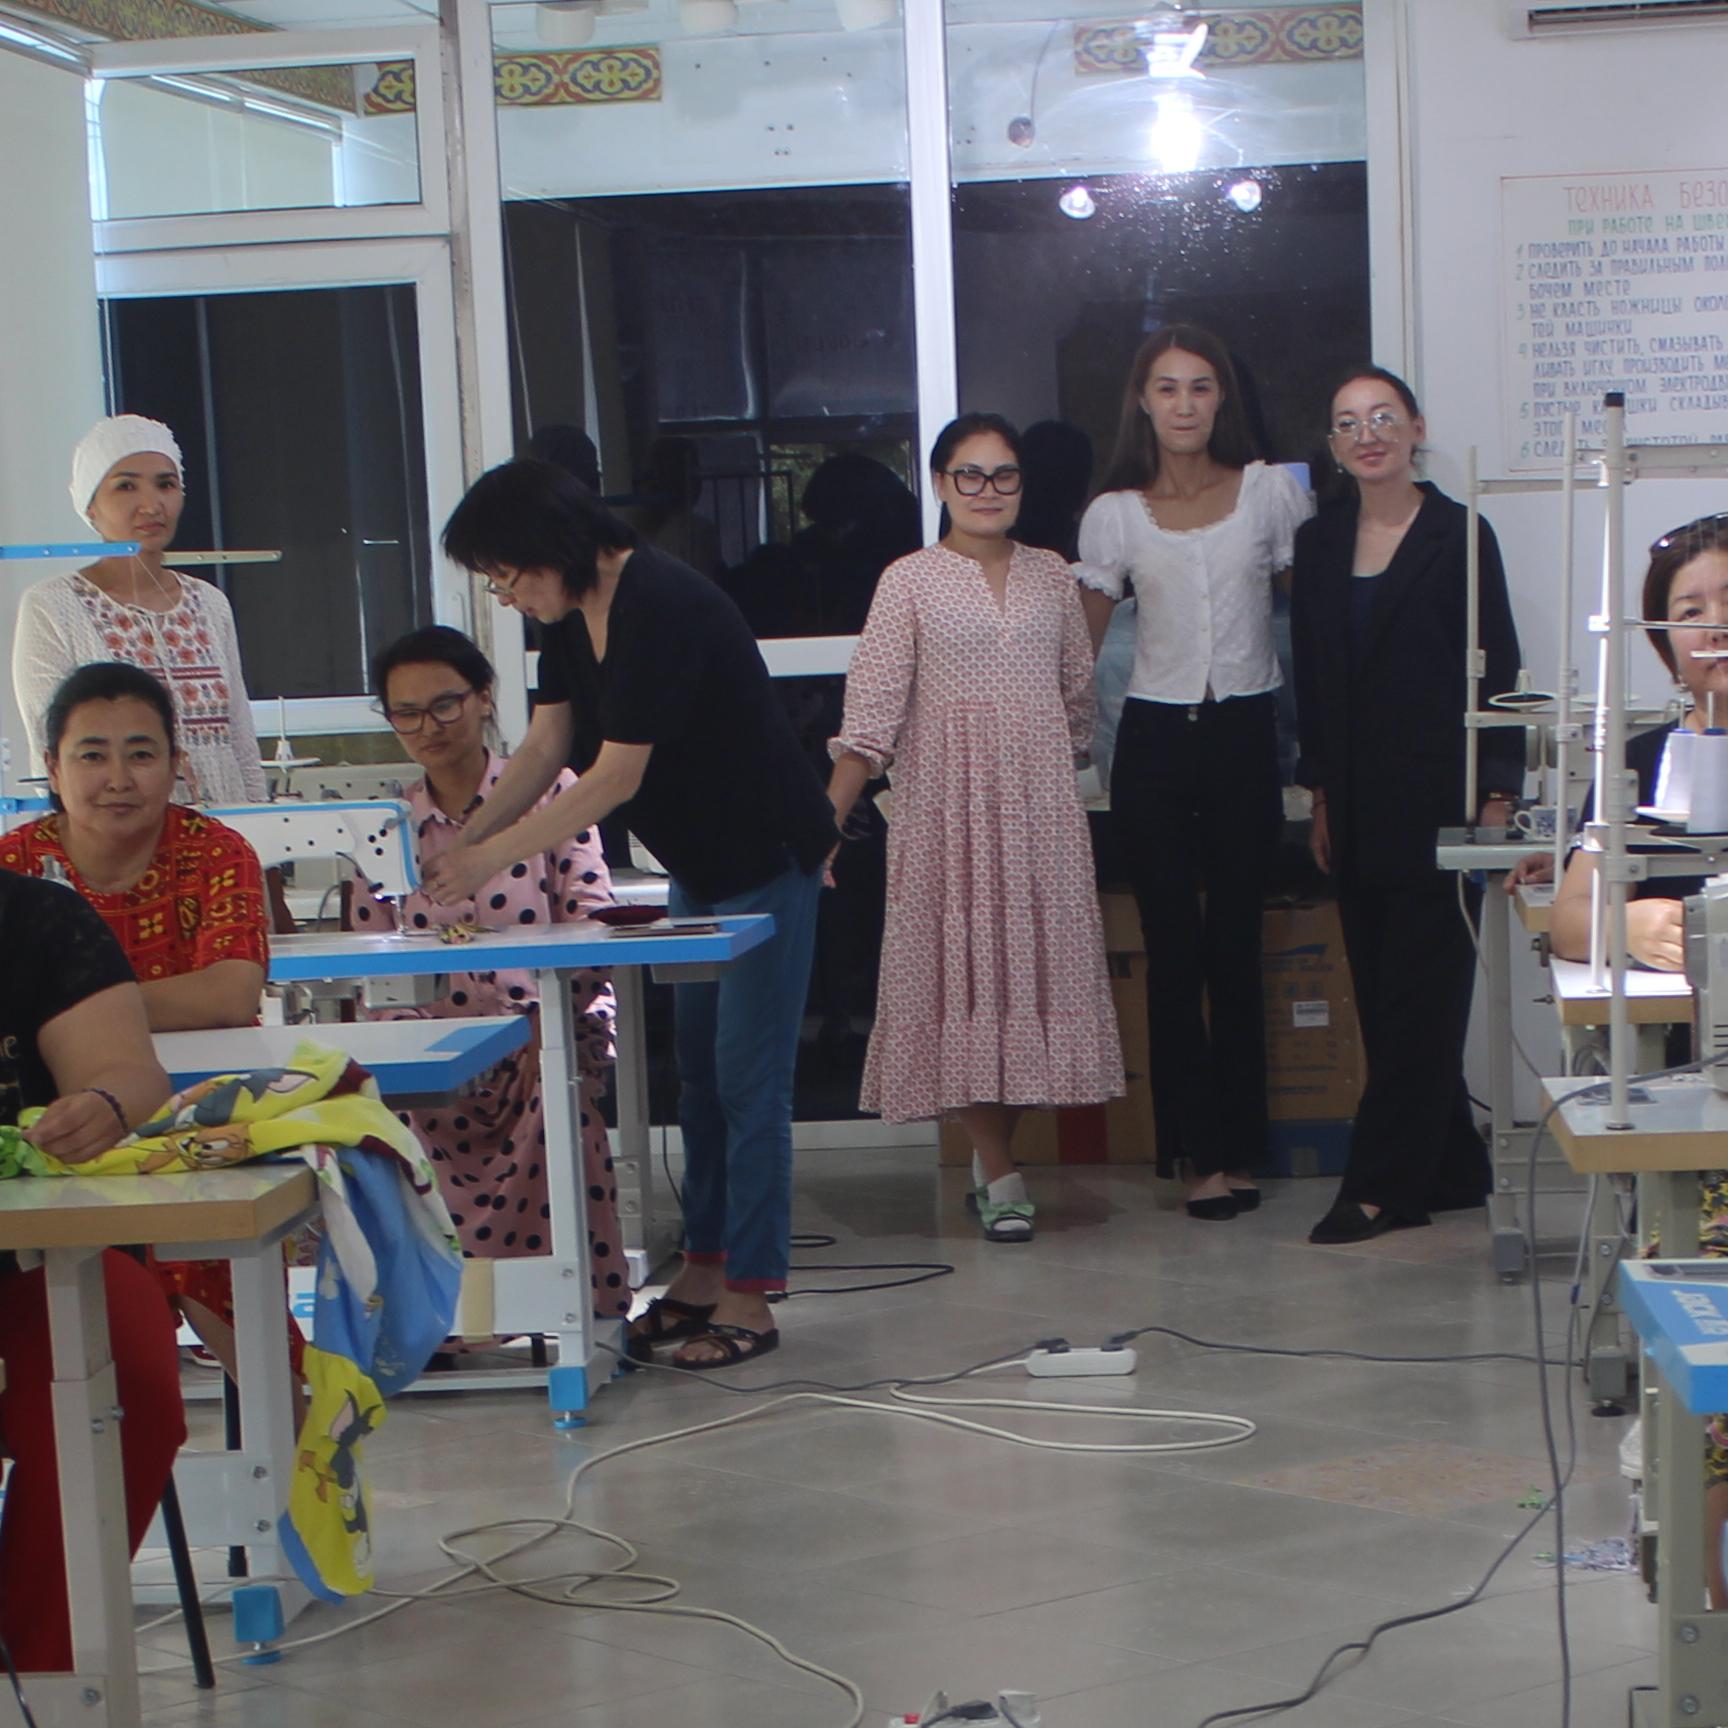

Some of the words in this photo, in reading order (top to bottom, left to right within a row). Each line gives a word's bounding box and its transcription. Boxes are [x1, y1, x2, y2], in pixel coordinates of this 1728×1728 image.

[1563, 184, 1654, 212] ТЕХНИКА
[1568, 218, 1595, 235] ПРИ
[1602, 216, 1654, 233] РАБОТЕ
[1665, 214, 1684, 231] НА
[1528, 240, 1593, 258] ПРОВЕРИТЬ
[1601, 240, 1617, 257] ДО
[1623, 237, 1669, 254] НАЧАЛА
[1589, 259, 1602, 276] ЗА
[1529, 282, 1572, 300] БОЧЕМ
[1530, 302, 1545, 319] НЕ
[1552, 300, 1600, 317] КЛАСТЬ
[1533, 381, 1556, 398] ПРИ
